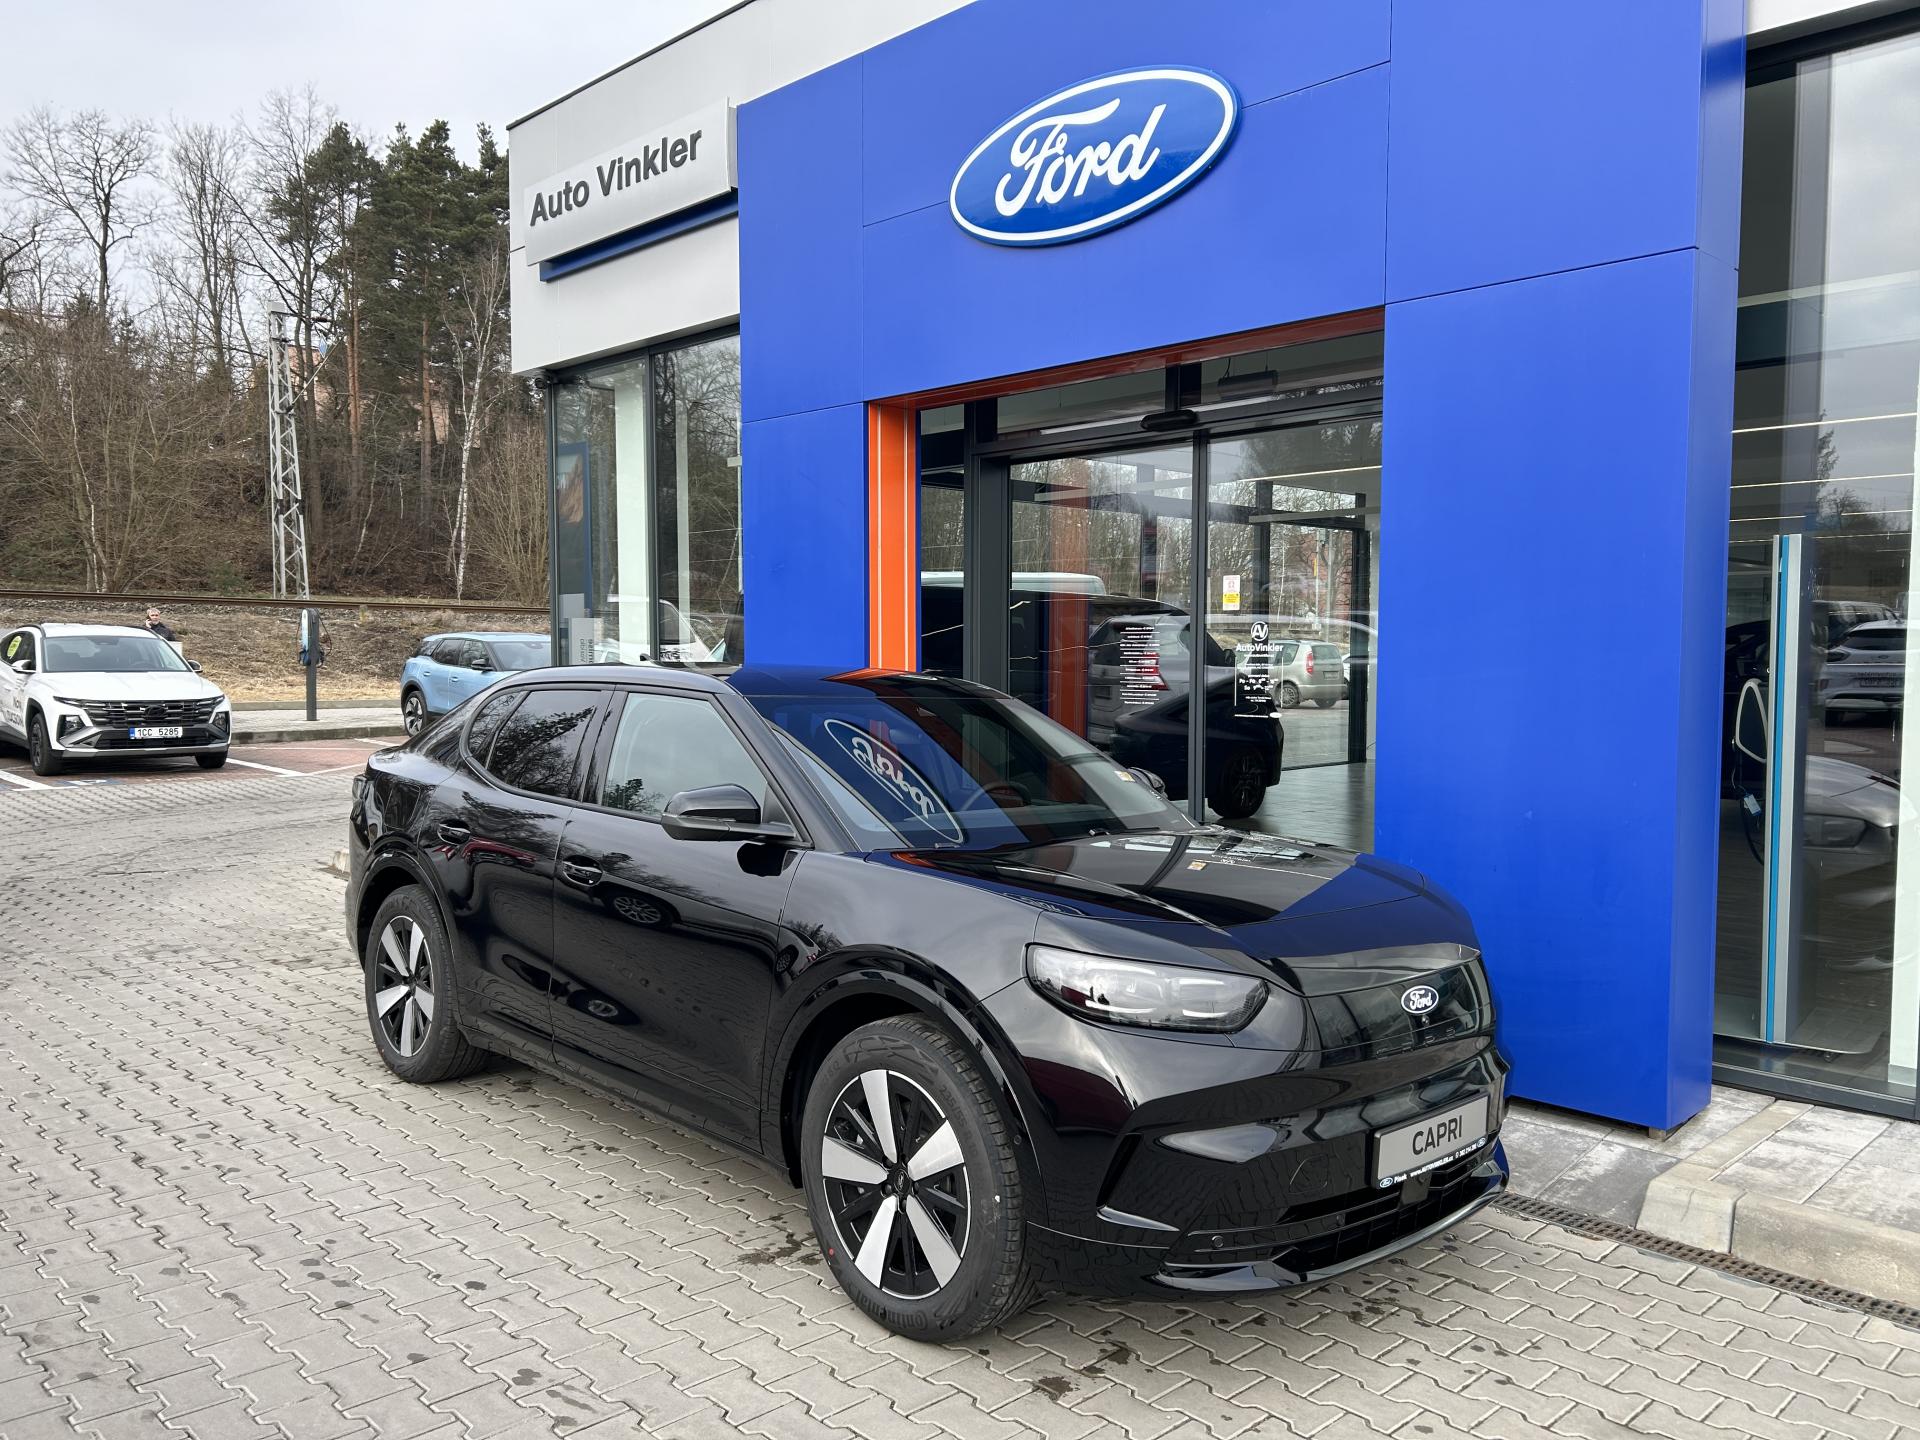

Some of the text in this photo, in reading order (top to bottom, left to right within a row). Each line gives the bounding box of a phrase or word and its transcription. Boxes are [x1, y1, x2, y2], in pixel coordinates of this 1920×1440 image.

[994, 97, 1168, 217] Ford
[529, 128, 703, 228] Auto Vinkler
[1235, 642, 1285, 652] AutoVinkler
[137, 727, 179, 737] 1CC 5285
[1409, 989, 1433, 1011] Ford
[1412, 1114, 1463, 1156] CAPRI
